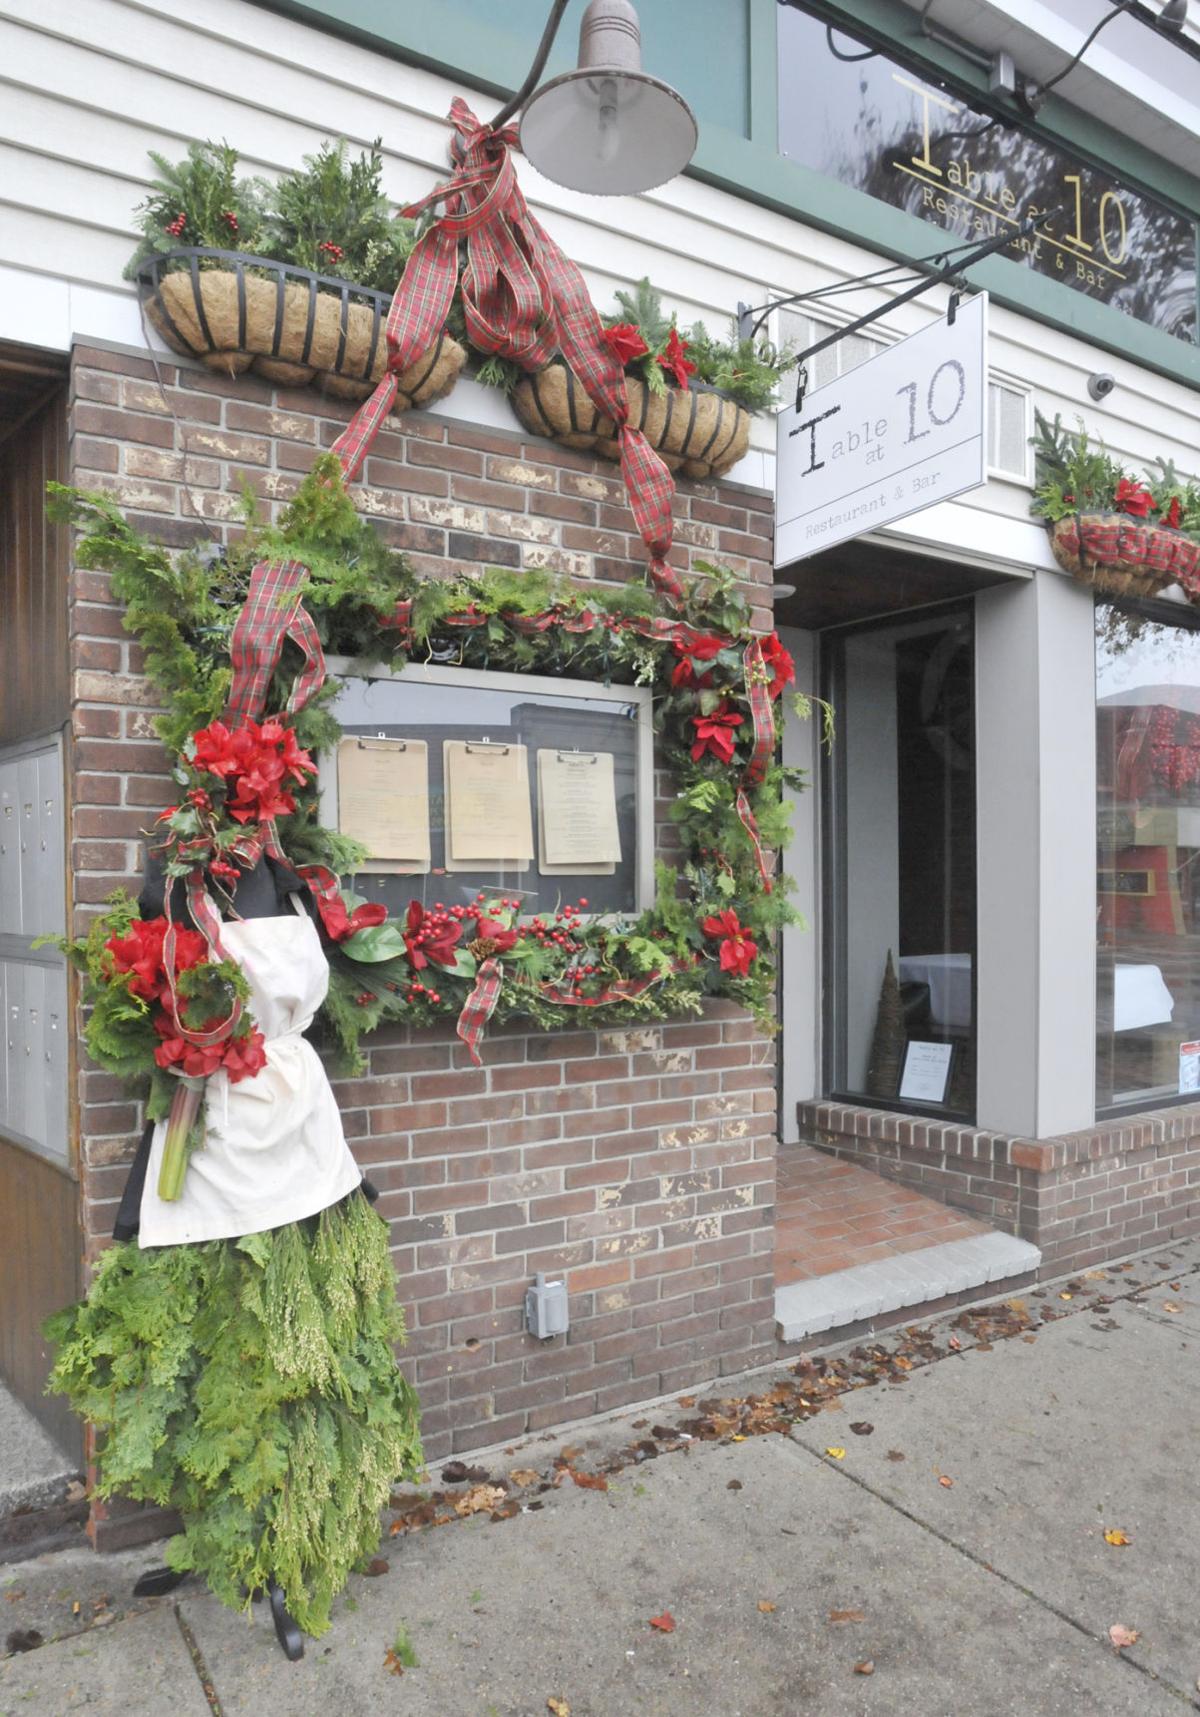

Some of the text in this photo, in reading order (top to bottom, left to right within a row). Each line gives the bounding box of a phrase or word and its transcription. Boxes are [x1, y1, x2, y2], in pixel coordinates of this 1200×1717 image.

[892, 73, 1016, 211] Table
[1064, 175, 1126, 264] 10
[1055, 253, 1064, 269] &
[1076, 262, 1104, 289] Bar
[789, 359, 965, 477] Table at 10
[805, 471, 941, 539] Restaurant & Bar
